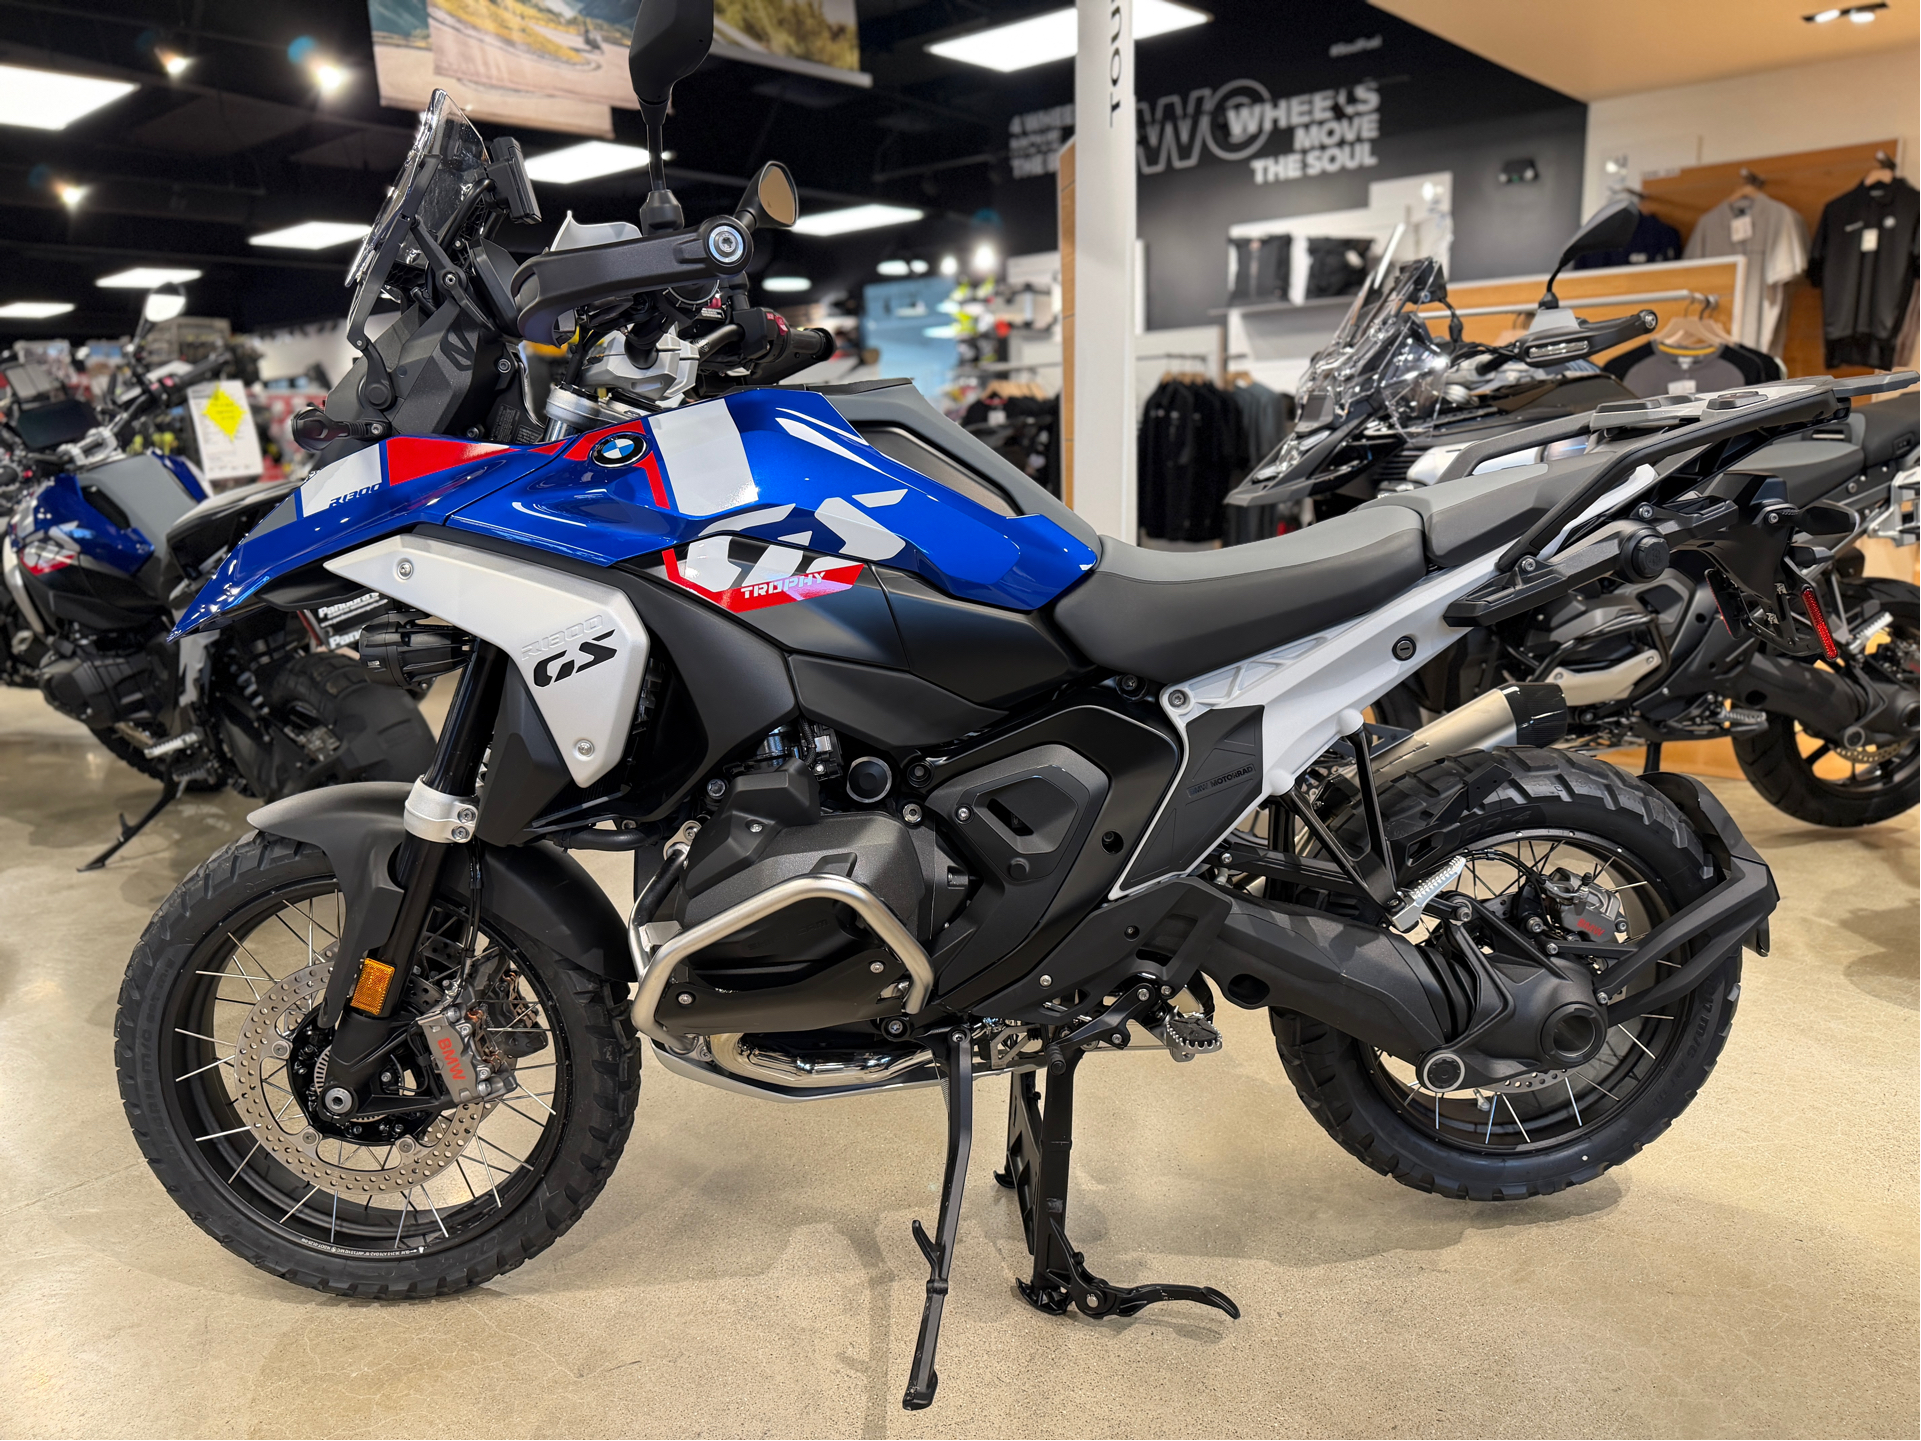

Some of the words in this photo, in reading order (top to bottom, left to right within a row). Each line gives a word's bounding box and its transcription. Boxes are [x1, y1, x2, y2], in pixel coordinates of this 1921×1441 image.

[1109, 0, 1122, 128] TOU
[1226, 82, 1381, 138] WHEELS
[1293, 113, 1381, 151] MOVE
[1250, 152, 1303, 185] THE
[1305, 141, 1379, 176] SOUL
[740, 571, 826, 599] TROPHY
[533, 628, 618, 688] GS
[1210, 765, 1254, 788] MOTORRAD
[1577, 918, 1606, 937] BMW
[437, 1037, 467, 1081] BMW
